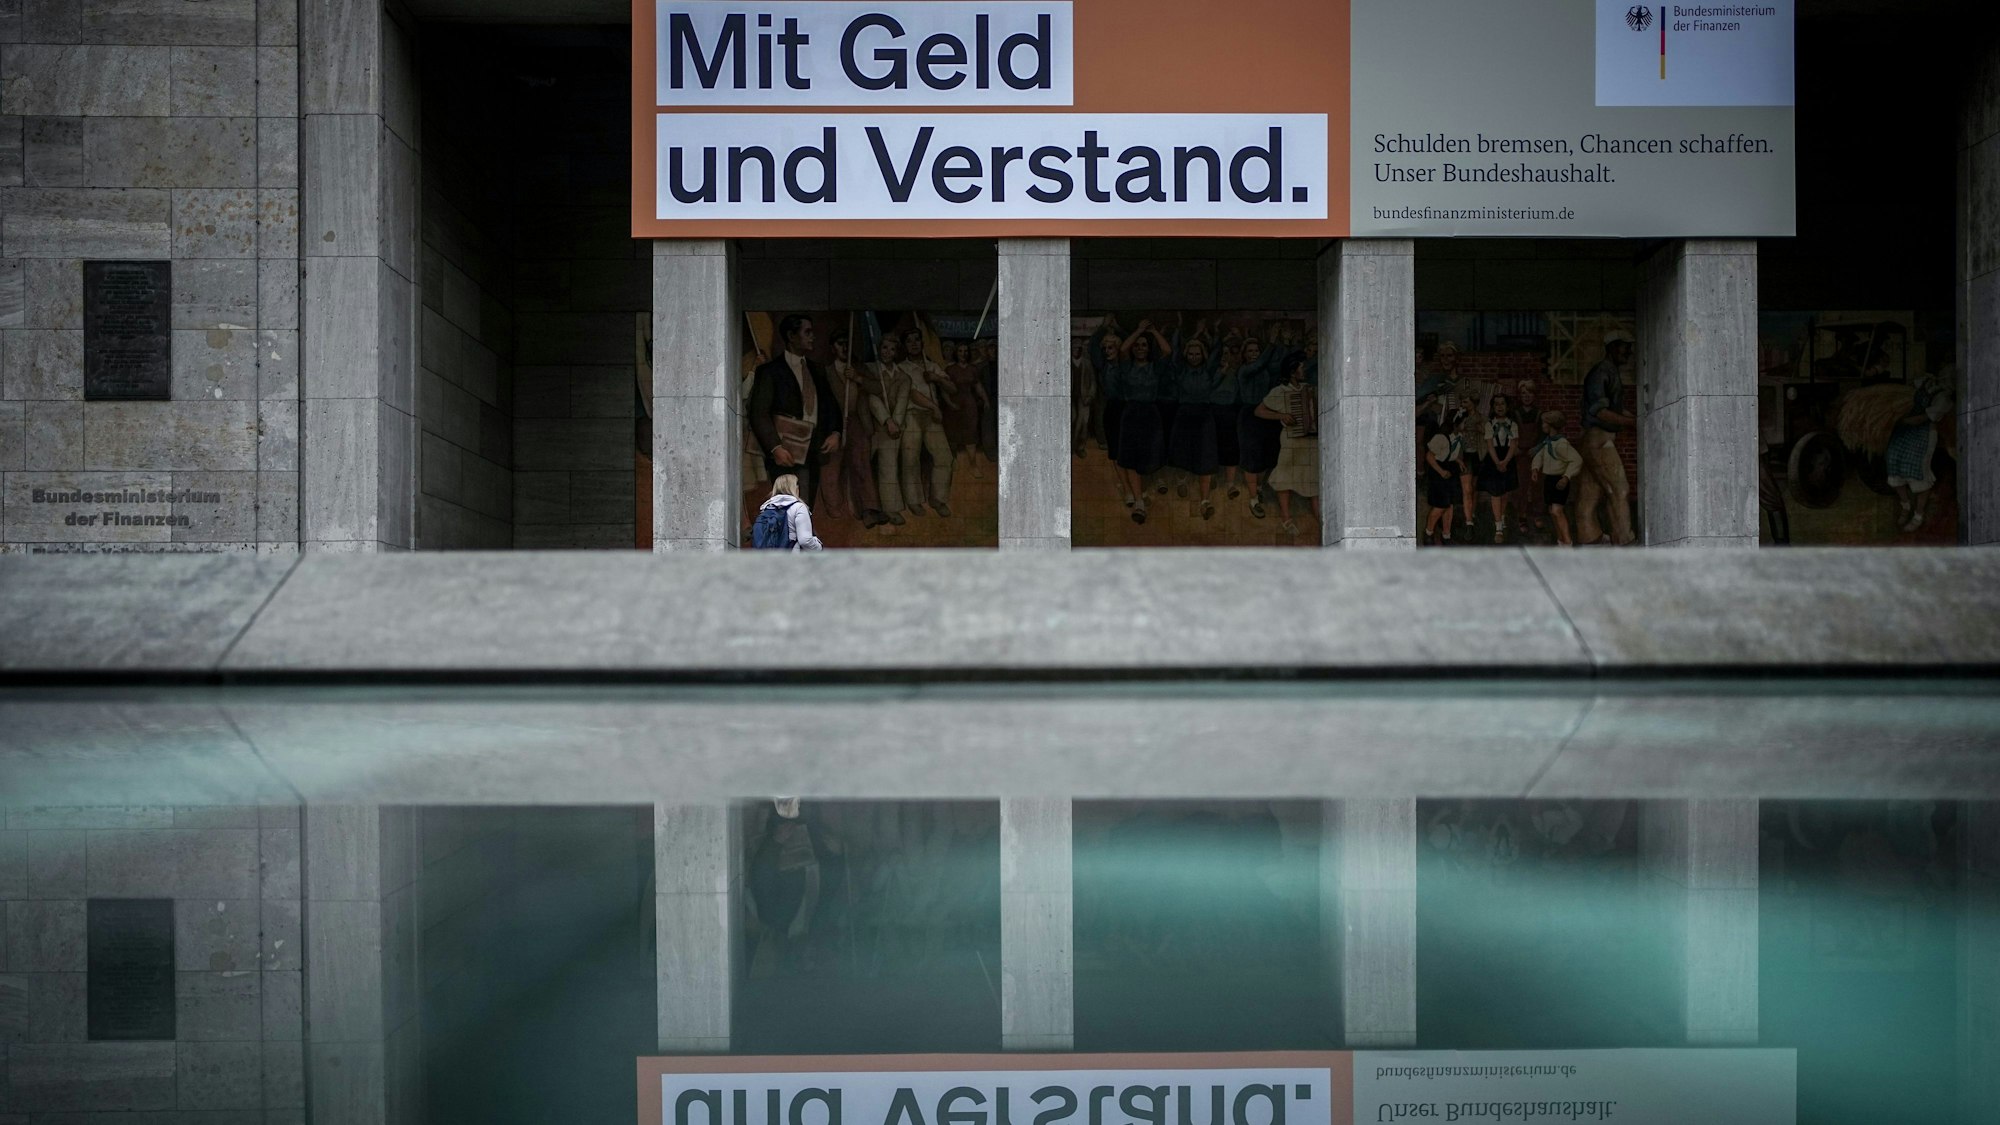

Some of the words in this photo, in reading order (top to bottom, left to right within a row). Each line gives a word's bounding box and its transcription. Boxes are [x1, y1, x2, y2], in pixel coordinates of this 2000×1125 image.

[1673, 4, 1776, 17] Bundesministerium
[1673, 19, 1690, 32] der
[1693, 19, 1740, 31] Finanzen
[669, 12, 811, 90] Mit
[839, 12, 1051, 91] Geld
[1374, 133, 1472, 154] Schulden
[1477, 133, 1574, 157] bremsen,
[1580, 133, 1673, 154] Chancen
[1679, 133, 1774, 154] schaffen.
[669, 126, 837, 204] und
[863, 126, 1308, 204] Verstand.
[1374, 163, 1437, 182] Unser
[1442, 162, 1616, 183] Bundeshaushalt.
[1373, 206, 1575, 220] bundesfinanzministerium.de
[32, 489, 221, 504] Bundesministerium
[64, 511, 98, 527] der
[102, 511, 190, 527] Finanzen
